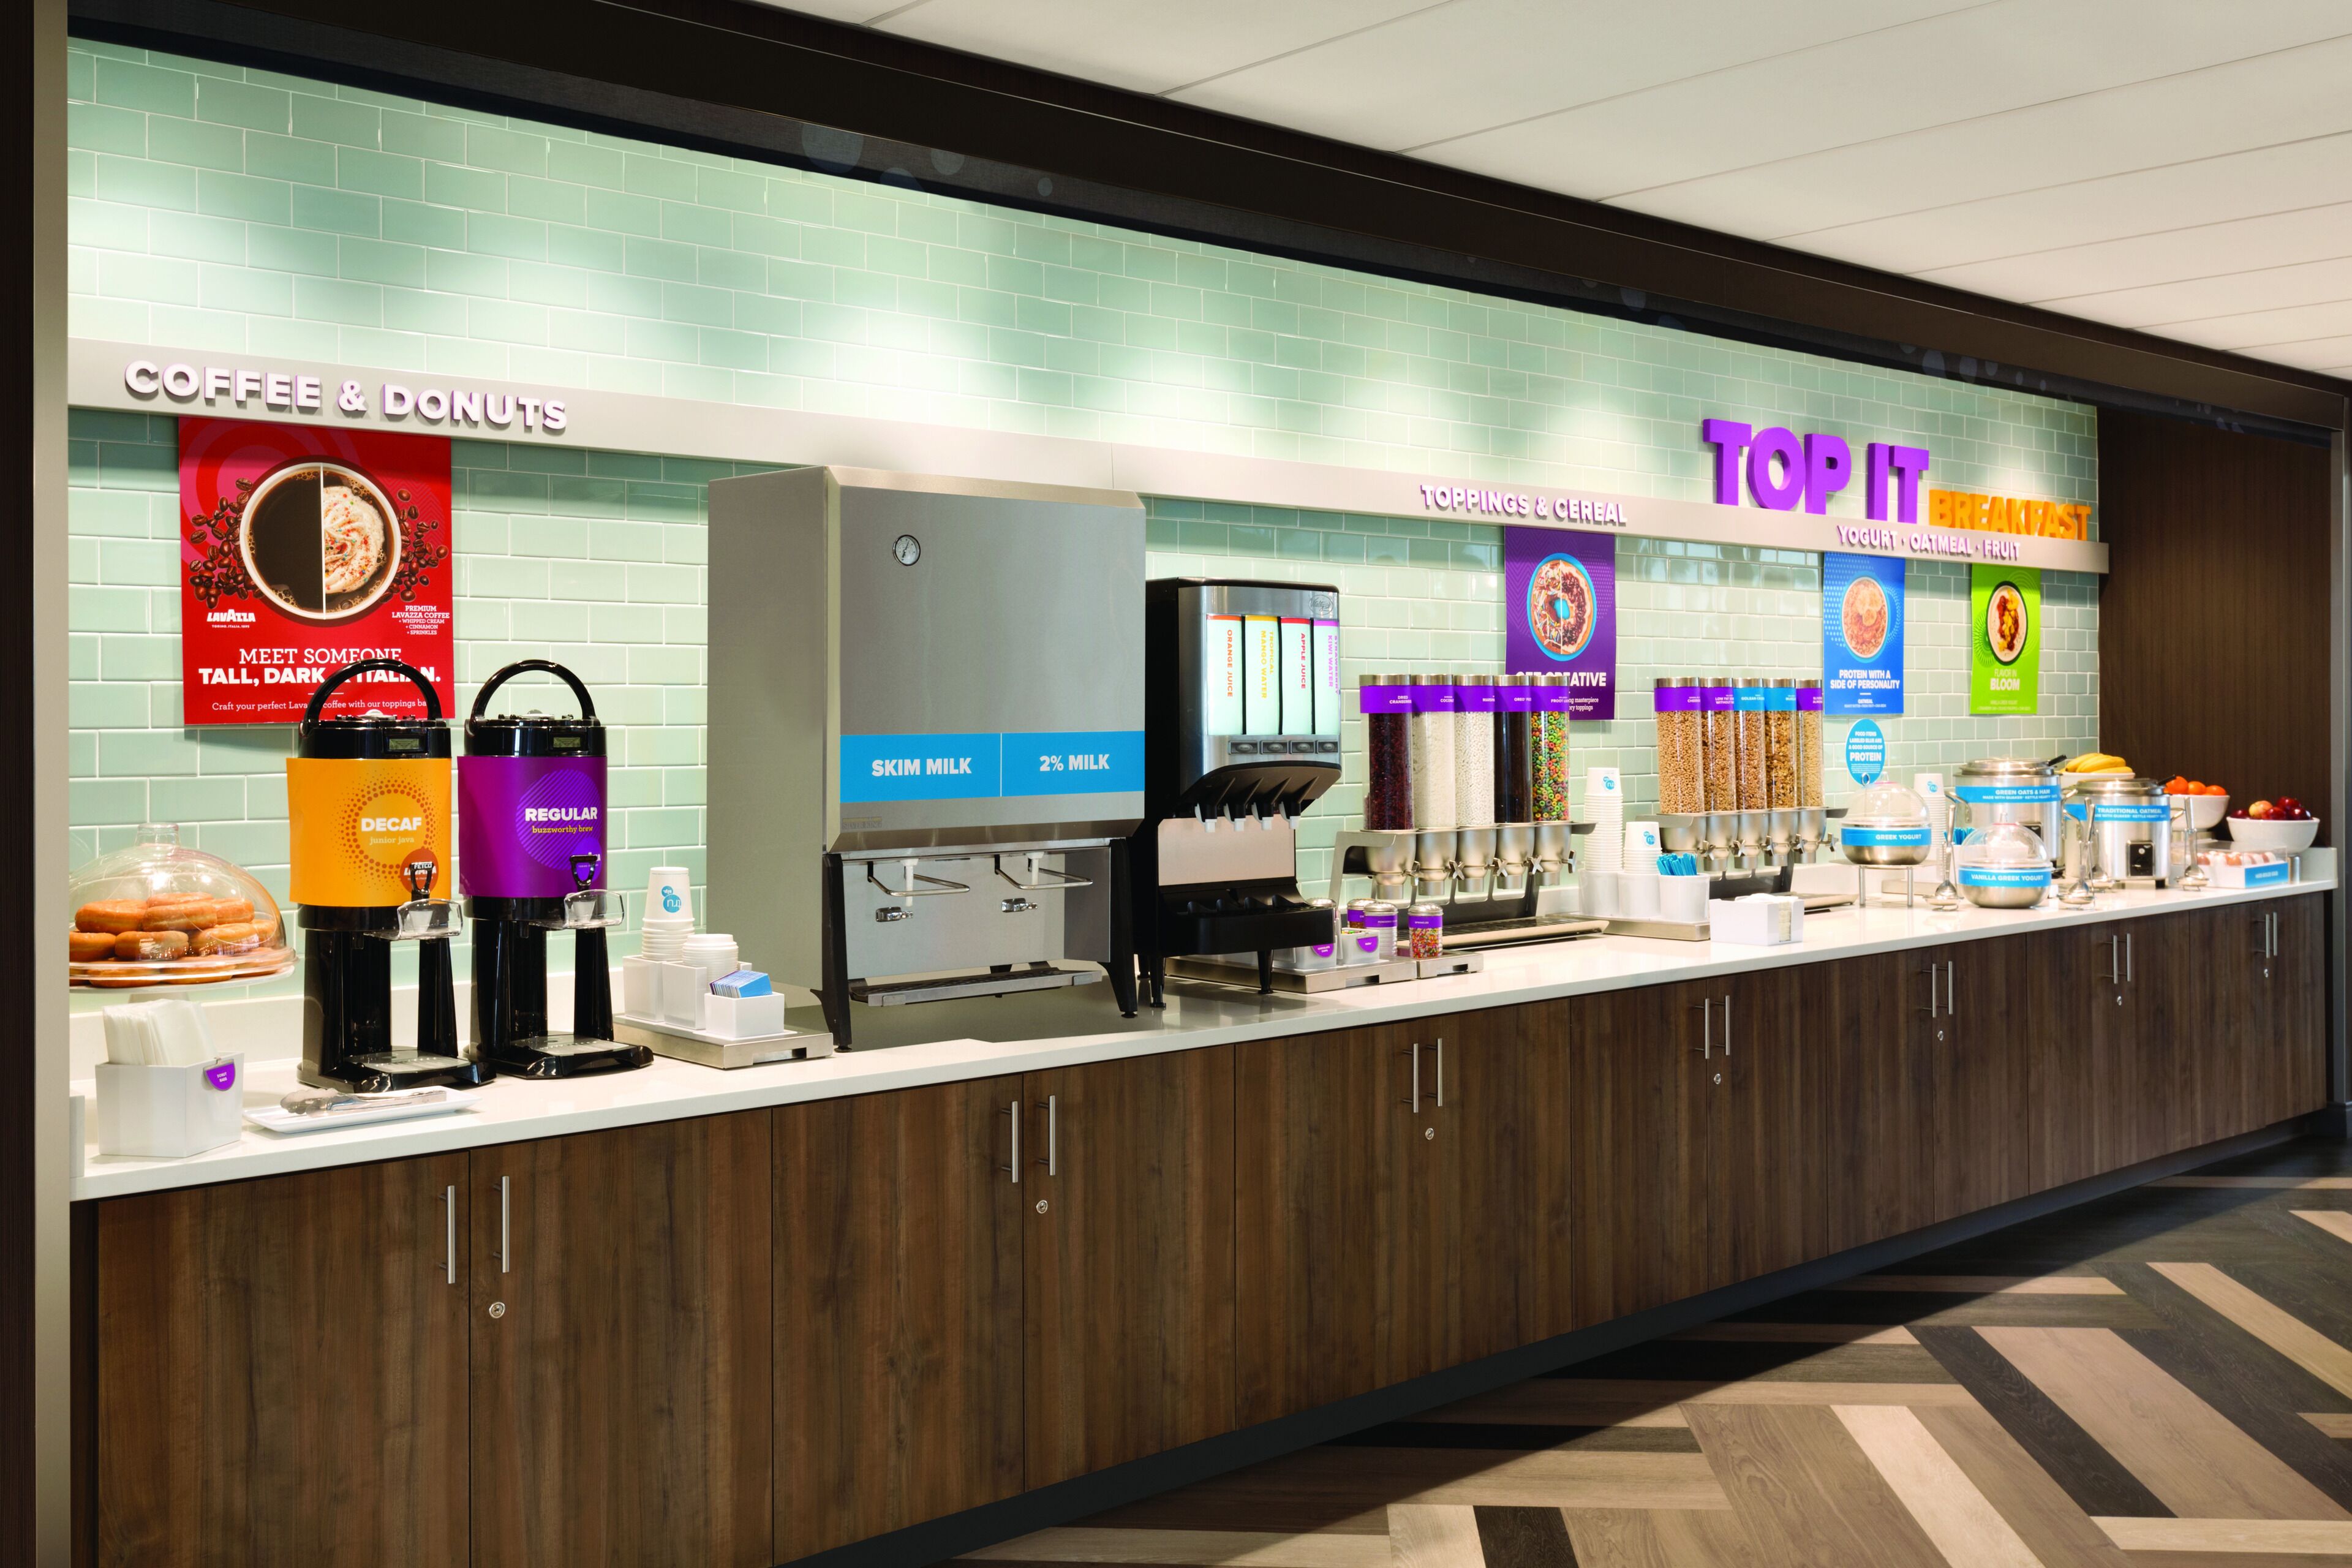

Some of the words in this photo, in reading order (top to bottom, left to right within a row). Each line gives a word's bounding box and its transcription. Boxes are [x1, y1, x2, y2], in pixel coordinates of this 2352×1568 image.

[124, 360, 322, 408] COFFEE
[337, 380, 367, 412] &
[383, 383, 568, 430] DONUTS
[1703, 418, 1852, 515] TOP
[1866, 442, 1929, 524] IT
[1420, 484, 1530, 515] TOPPINGS
[1535, 496, 1548, 517] &
[1553, 497, 1627, 523] CEREAL
[1929, 489, 2092, 541] BREAKFAST
[1837, 525, 1898, 548] YOGURT
[1910, 532, 1973, 555] OATMEAL
[1983, 539, 2021, 559] FRUIT
[206, 609, 256, 622] LAVAZZA
[239, 648, 298, 665] MEET
[304, 648, 402, 664] SOMEONE
[198, 668, 260, 687] TALL,
[264, 668, 326, 684] DARK
[1839, 669, 1868, 679] PROTEIN
[1868, 669, 1885, 679] WITH
[1885, 670, 1891, 679] A
[2012, 668, 2018, 677] IN
[1830, 679, 1846, 689] SIDE
[1847, 680, 1857, 689] OF
[1857, 680, 1900, 689] PERSONALITY
[1989, 677, 2020, 691] BLOOM
[212, 701, 233, 710] Craft
[257, 701, 287, 711] perfect
[323, 700, 347, 709] coffee
[382, 700, 416, 710] toppings
[417, 699, 427, 707] ba
[1039, 755, 1065, 772] 2%
[1068, 754, 1110, 771] MILK
[1850, 752, 1882, 761] PROTEIN
[872, 759, 921, 777] SKIM
[926, 757, 973, 775] MILK
[525, 807, 598, 821] REGULAR
[361, 817, 422, 832] DECAF
[532, 824, 577, 834] buzzworthy
[369, 836, 396, 846] junior
[398, 835, 415, 845] java
